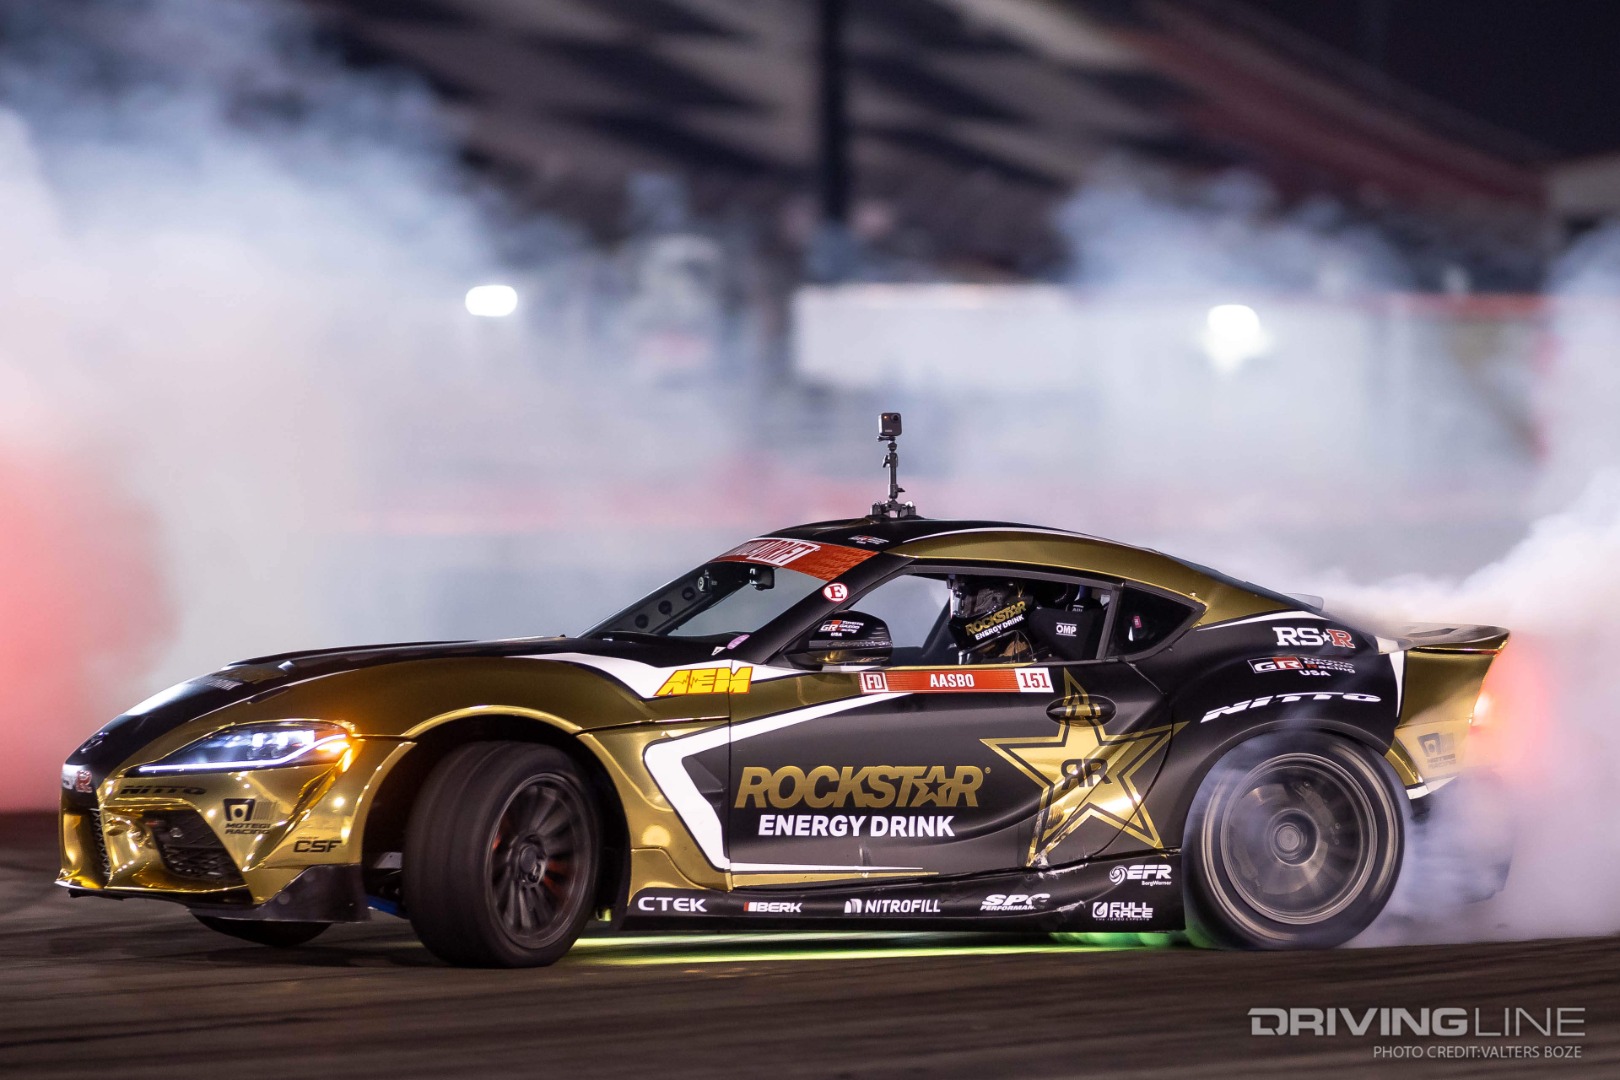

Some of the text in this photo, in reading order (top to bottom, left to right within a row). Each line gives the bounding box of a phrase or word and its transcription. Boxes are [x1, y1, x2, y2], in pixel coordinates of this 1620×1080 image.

[965, 600, 1026, 636] ROCKSTAR
[975, 614, 1025, 641] ENERGY DRINK
[1056, 625, 1077, 634] OMP
[1254, 659, 1301, 672] GR
[653, 666, 753, 697] AEM
[930, 673, 975, 688] AASBO
[1020, 672, 1050, 689] 151
[1201, 691, 1382, 723] NITTO
[120, 785, 207, 795] NITTO
[758, 814, 955, 837] ENERGY DRINK
[293, 840, 342, 852] CSF
[1127, 864, 1172, 880] EFR
[637, 896, 708, 912] CTEK
[756, 902, 802, 913] BERK
[865, 899, 941, 913] NITROFILL
[1110, 902, 1153, 910] FULL
[1109, 909, 1153, 918] RACE
